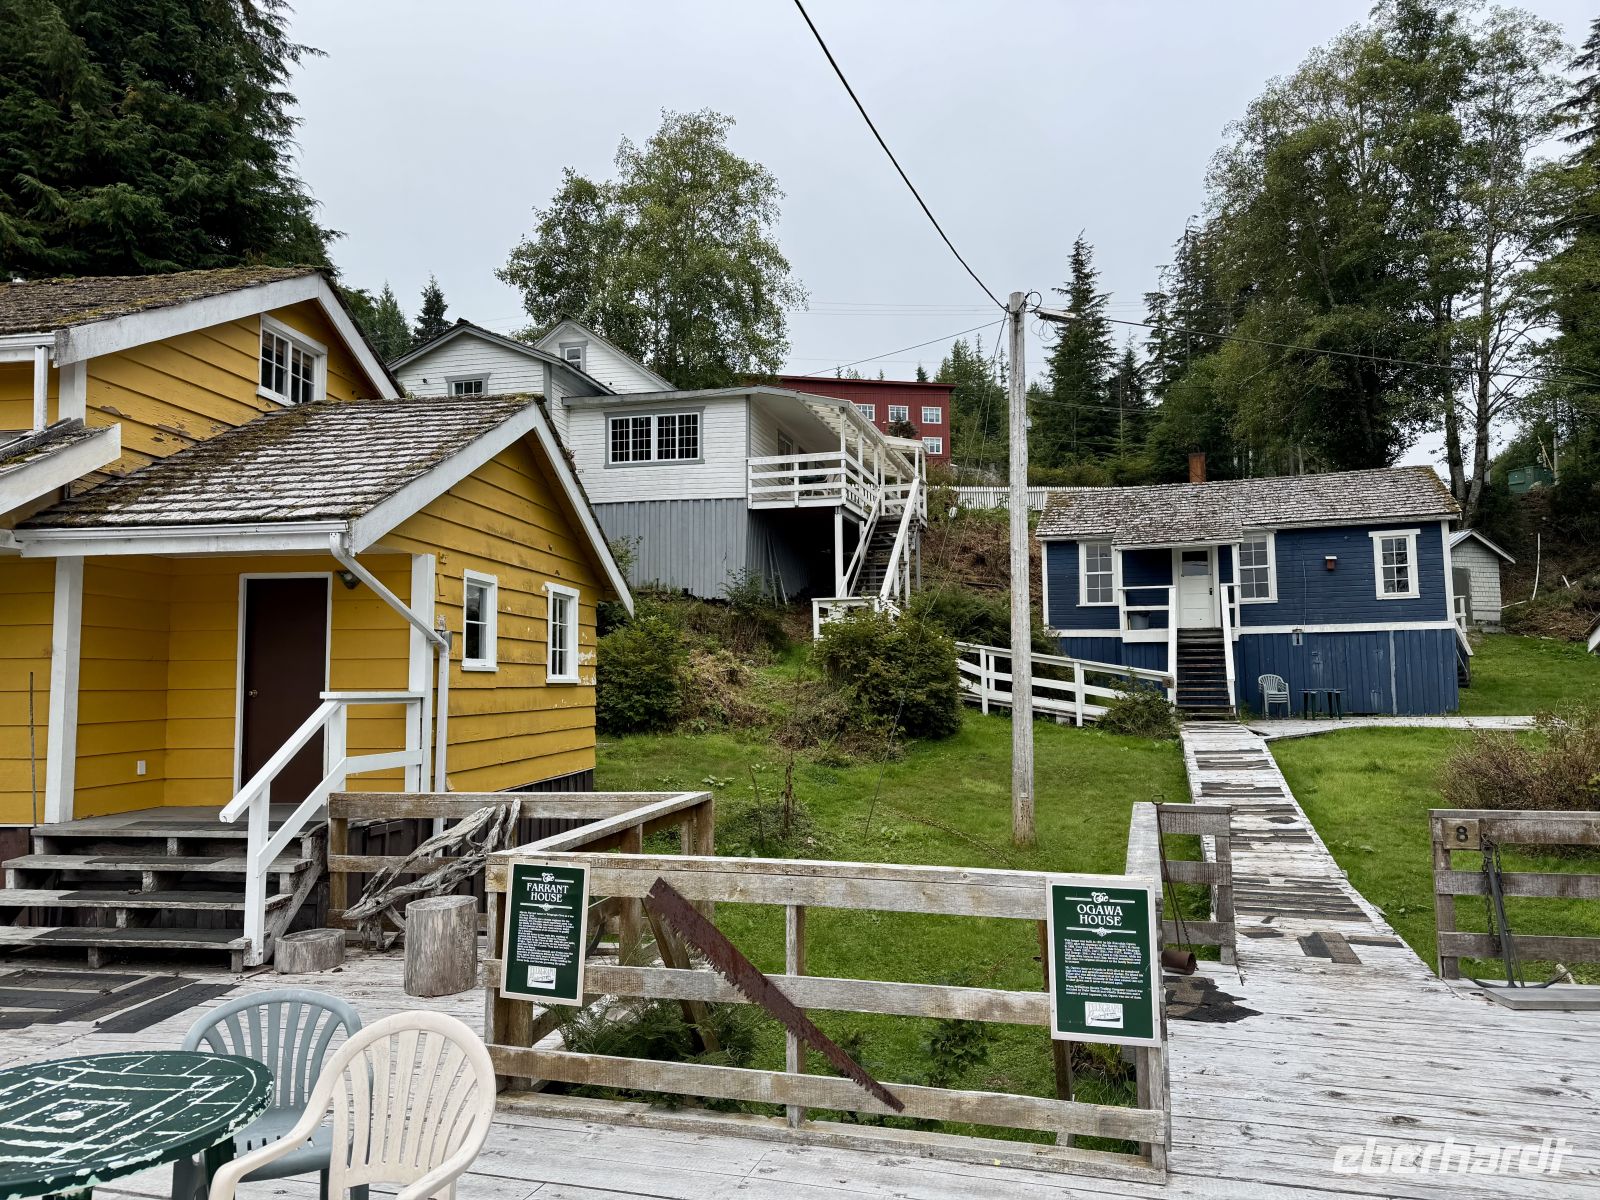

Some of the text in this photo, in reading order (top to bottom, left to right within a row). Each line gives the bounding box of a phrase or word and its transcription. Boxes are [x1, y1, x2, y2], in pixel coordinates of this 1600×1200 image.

[1456, 825, 1469, 842] 8
[526, 882, 569, 894] FARRANT
[530, 891, 563, 903] HOUSE
[1091, 891, 1109, 904] The
[1077, 904, 1123, 916] OGAWA
[1079, 914, 1122, 927] HOUSE
